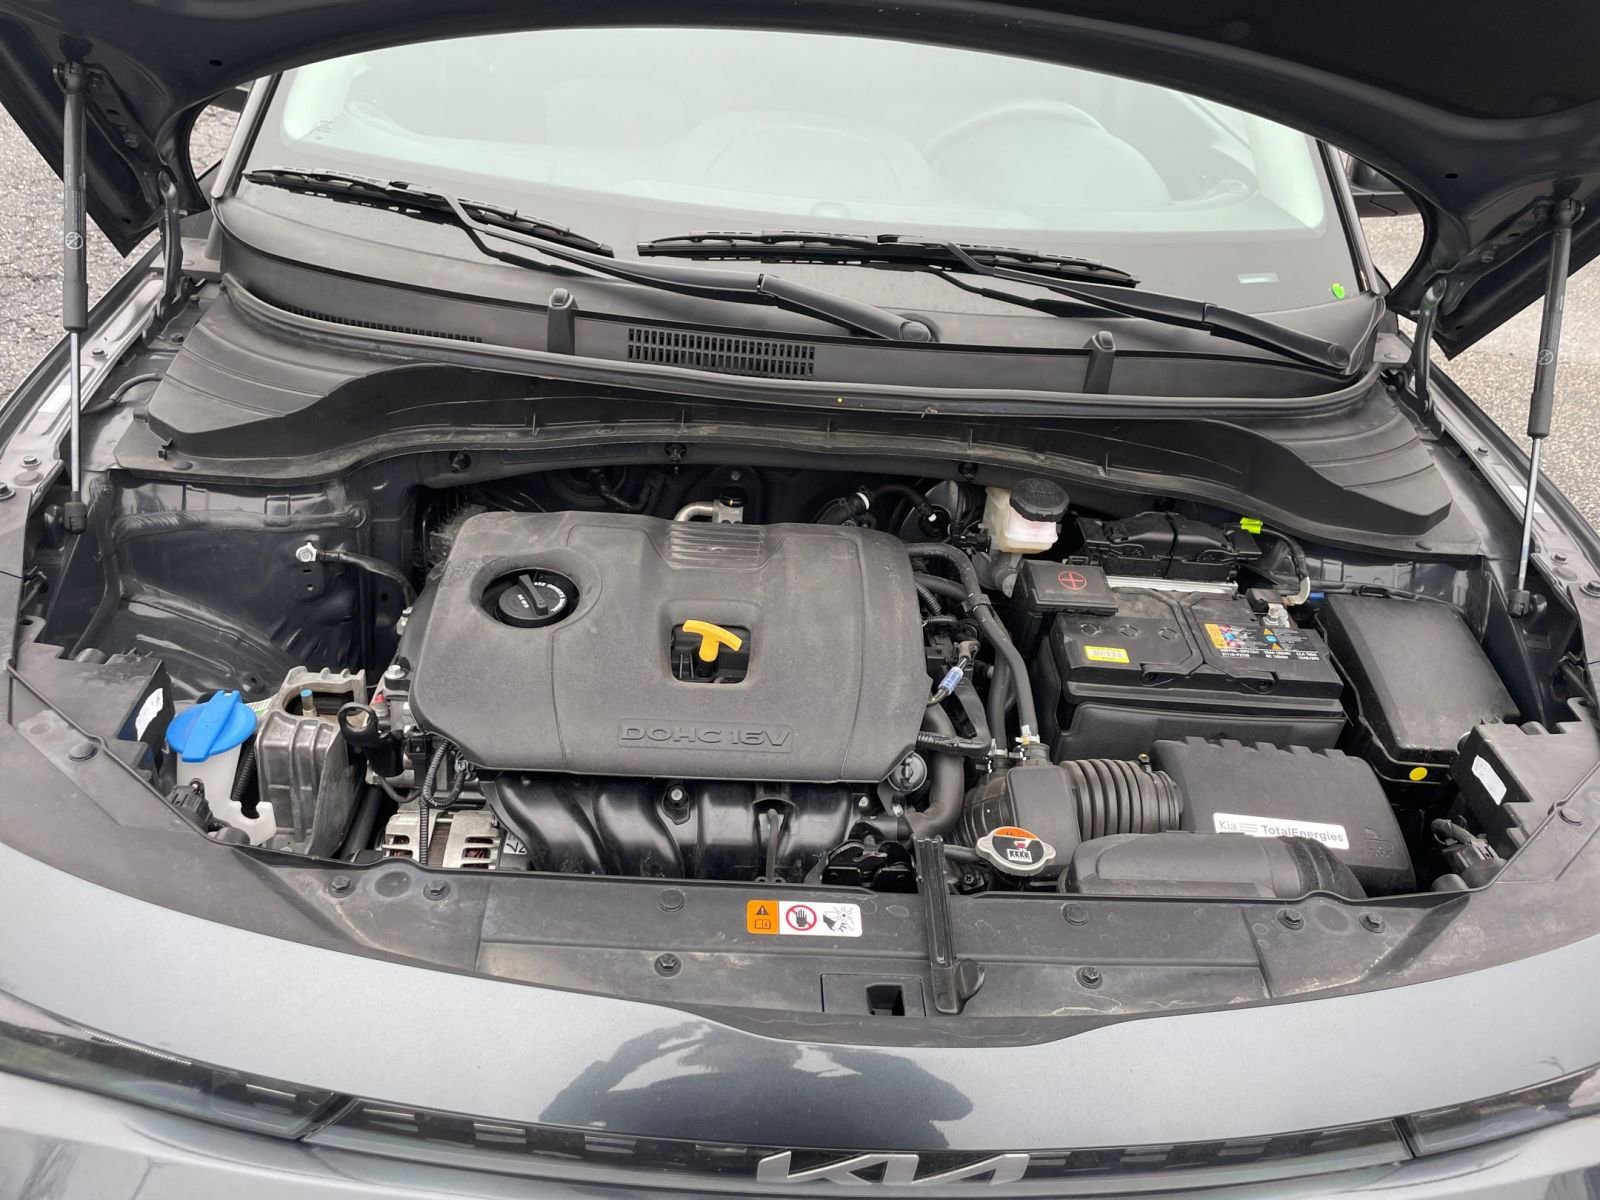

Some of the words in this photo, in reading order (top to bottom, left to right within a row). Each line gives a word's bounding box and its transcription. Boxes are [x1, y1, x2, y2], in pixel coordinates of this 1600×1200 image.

[621, 727, 721, 744] DOHC
[730, 729, 790, 747] 16V
[1218, 820, 1237, 831] Kia
[1261, 824, 1344, 842] TotalEnergies
[757, 1150, 1030, 1186] KIA
